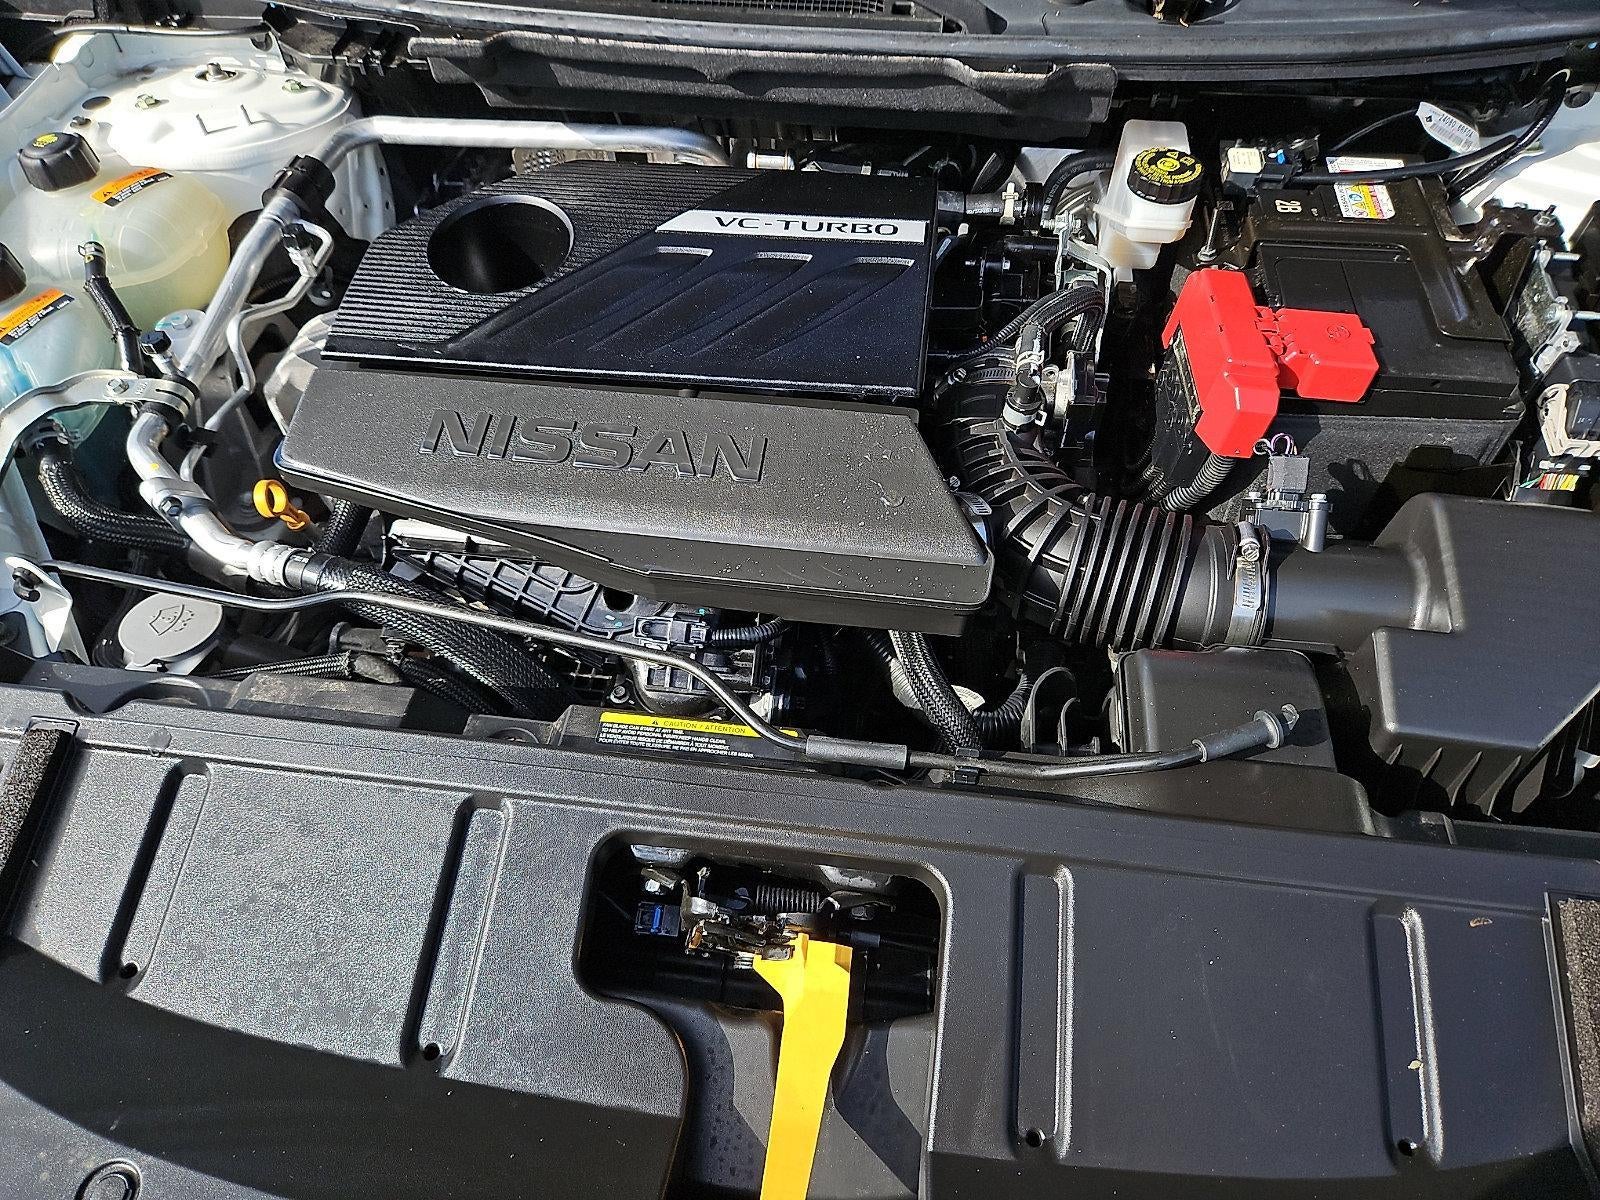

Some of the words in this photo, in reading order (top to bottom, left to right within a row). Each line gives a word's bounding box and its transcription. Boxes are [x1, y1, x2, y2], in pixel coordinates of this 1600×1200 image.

[715, 216, 899, 236] VC-TURBO
[418, 410, 769, 482] NISSAN
[664, 720, 697, 728] CAUTION
[705, 725, 745, 734] ATTENTION
